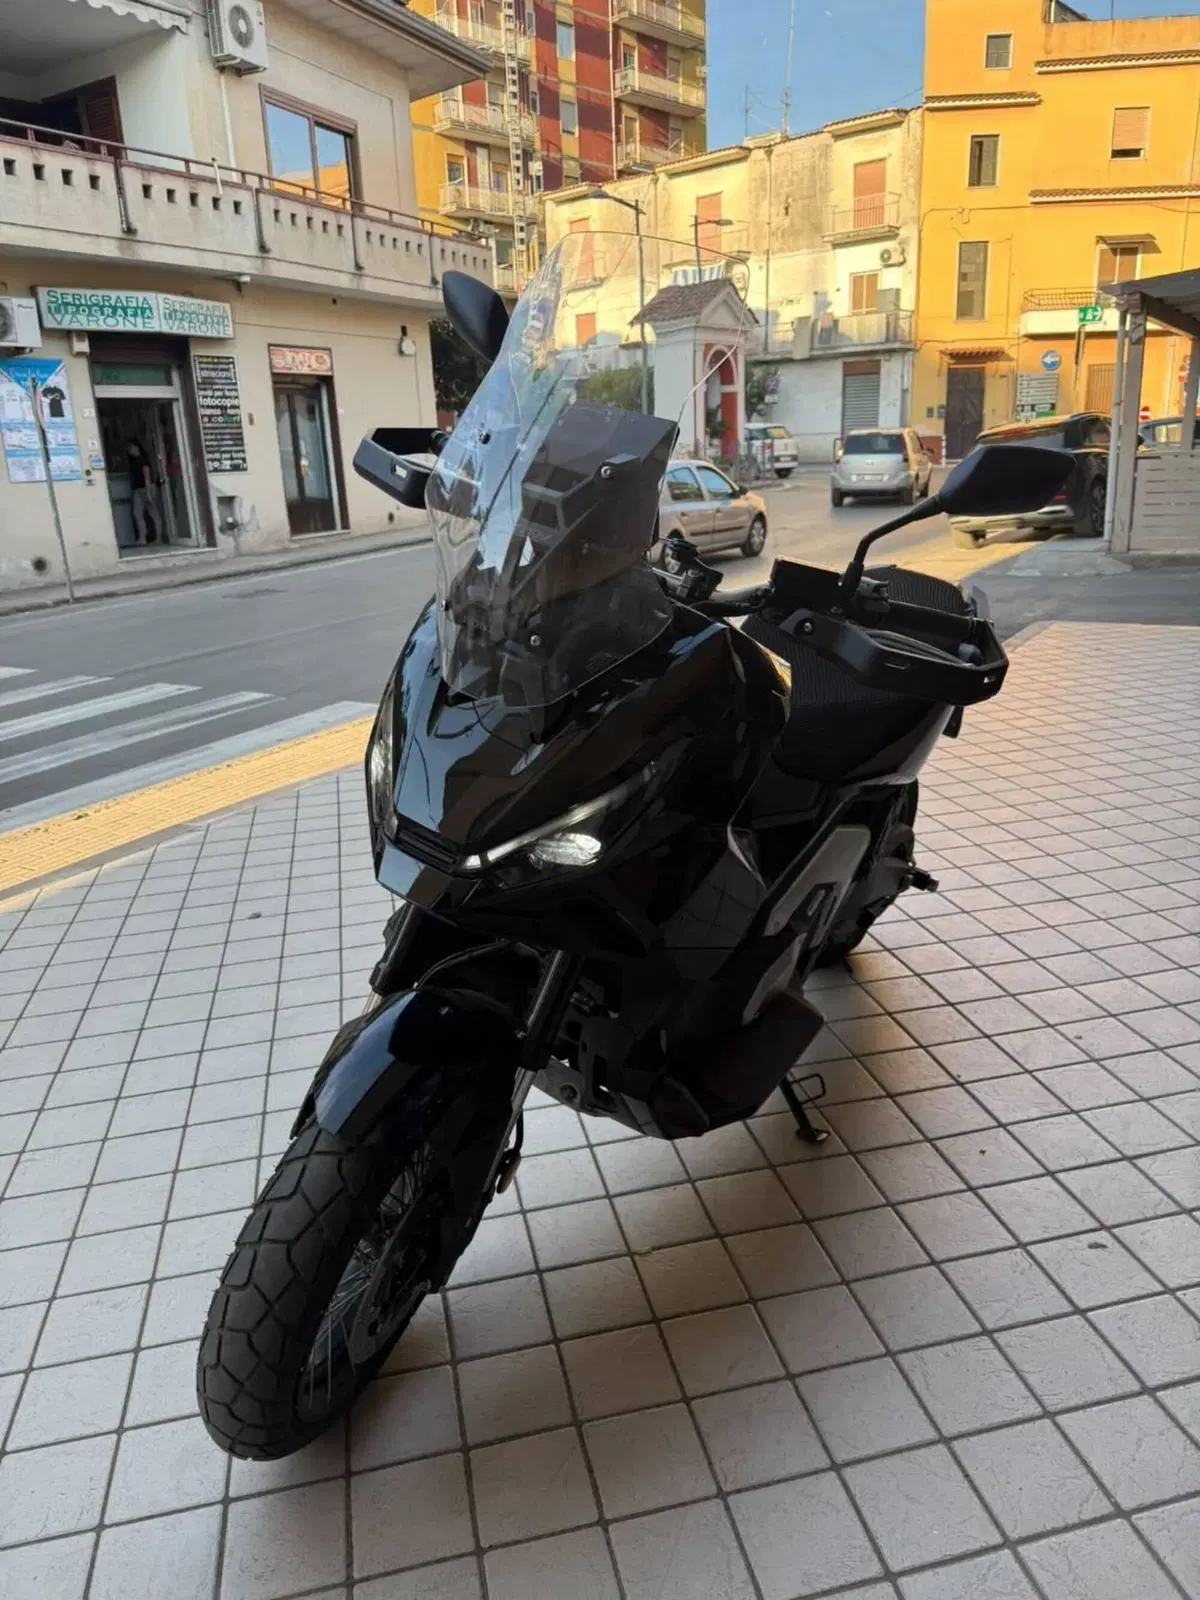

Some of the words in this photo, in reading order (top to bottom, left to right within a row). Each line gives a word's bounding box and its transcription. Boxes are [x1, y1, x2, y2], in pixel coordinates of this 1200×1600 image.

[46, 289, 152, 308] SERIGRAFIA
[163, 297, 229, 315] SERIGRAFIA
[50, 304, 153, 318] TIPOGRAFIA
[48, 312, 155, 329] VARONE
[165, 319, 230, 336] VARONE
